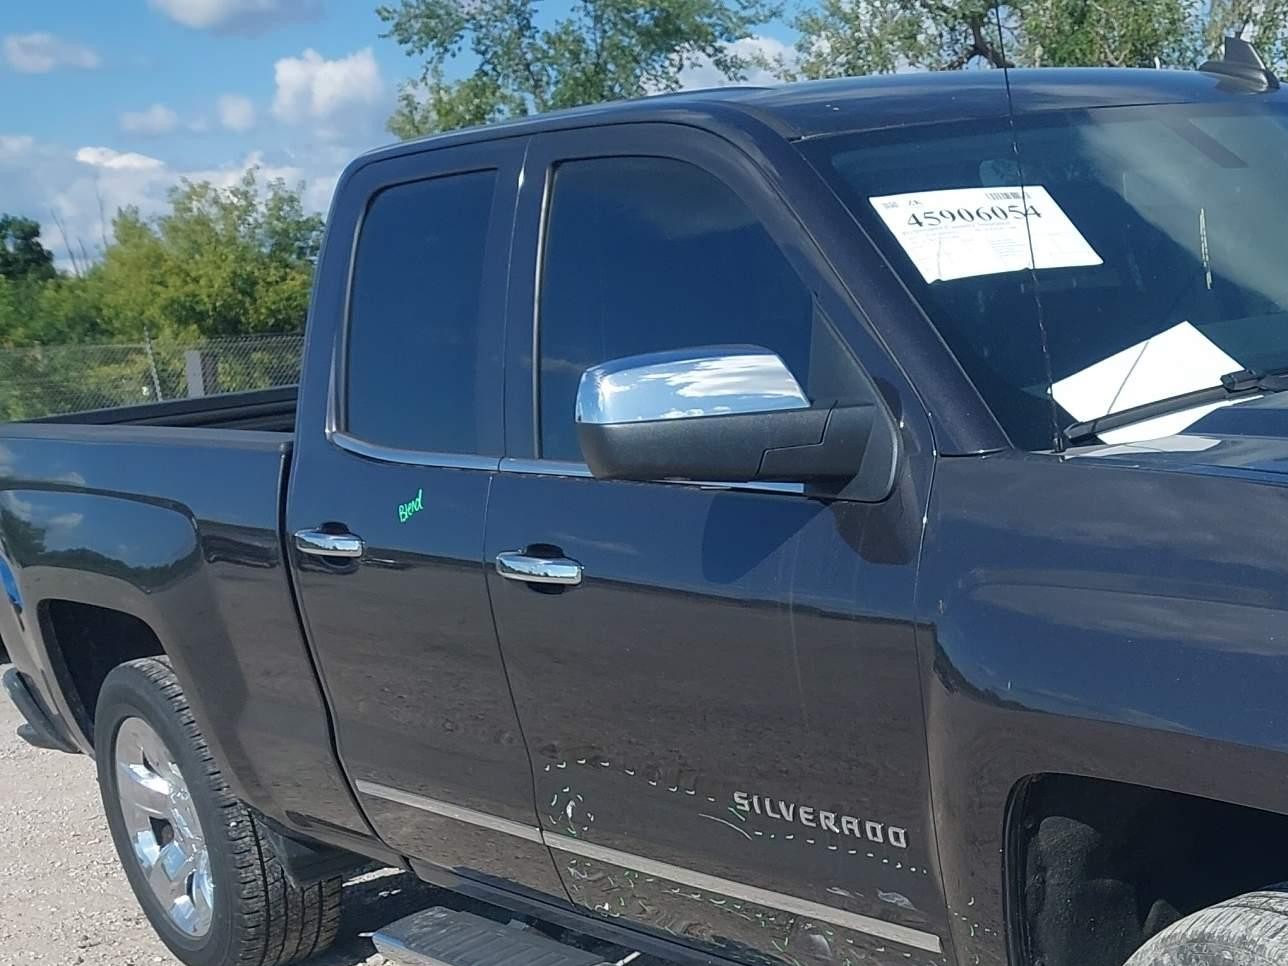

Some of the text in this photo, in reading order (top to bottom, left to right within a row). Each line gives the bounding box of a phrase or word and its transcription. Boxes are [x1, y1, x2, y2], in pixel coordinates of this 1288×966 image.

[906, 204, 1043, 228] 45906054
[398, 488, 424, 523] Blend
[733, 790, 908, 849] SILVERADO
